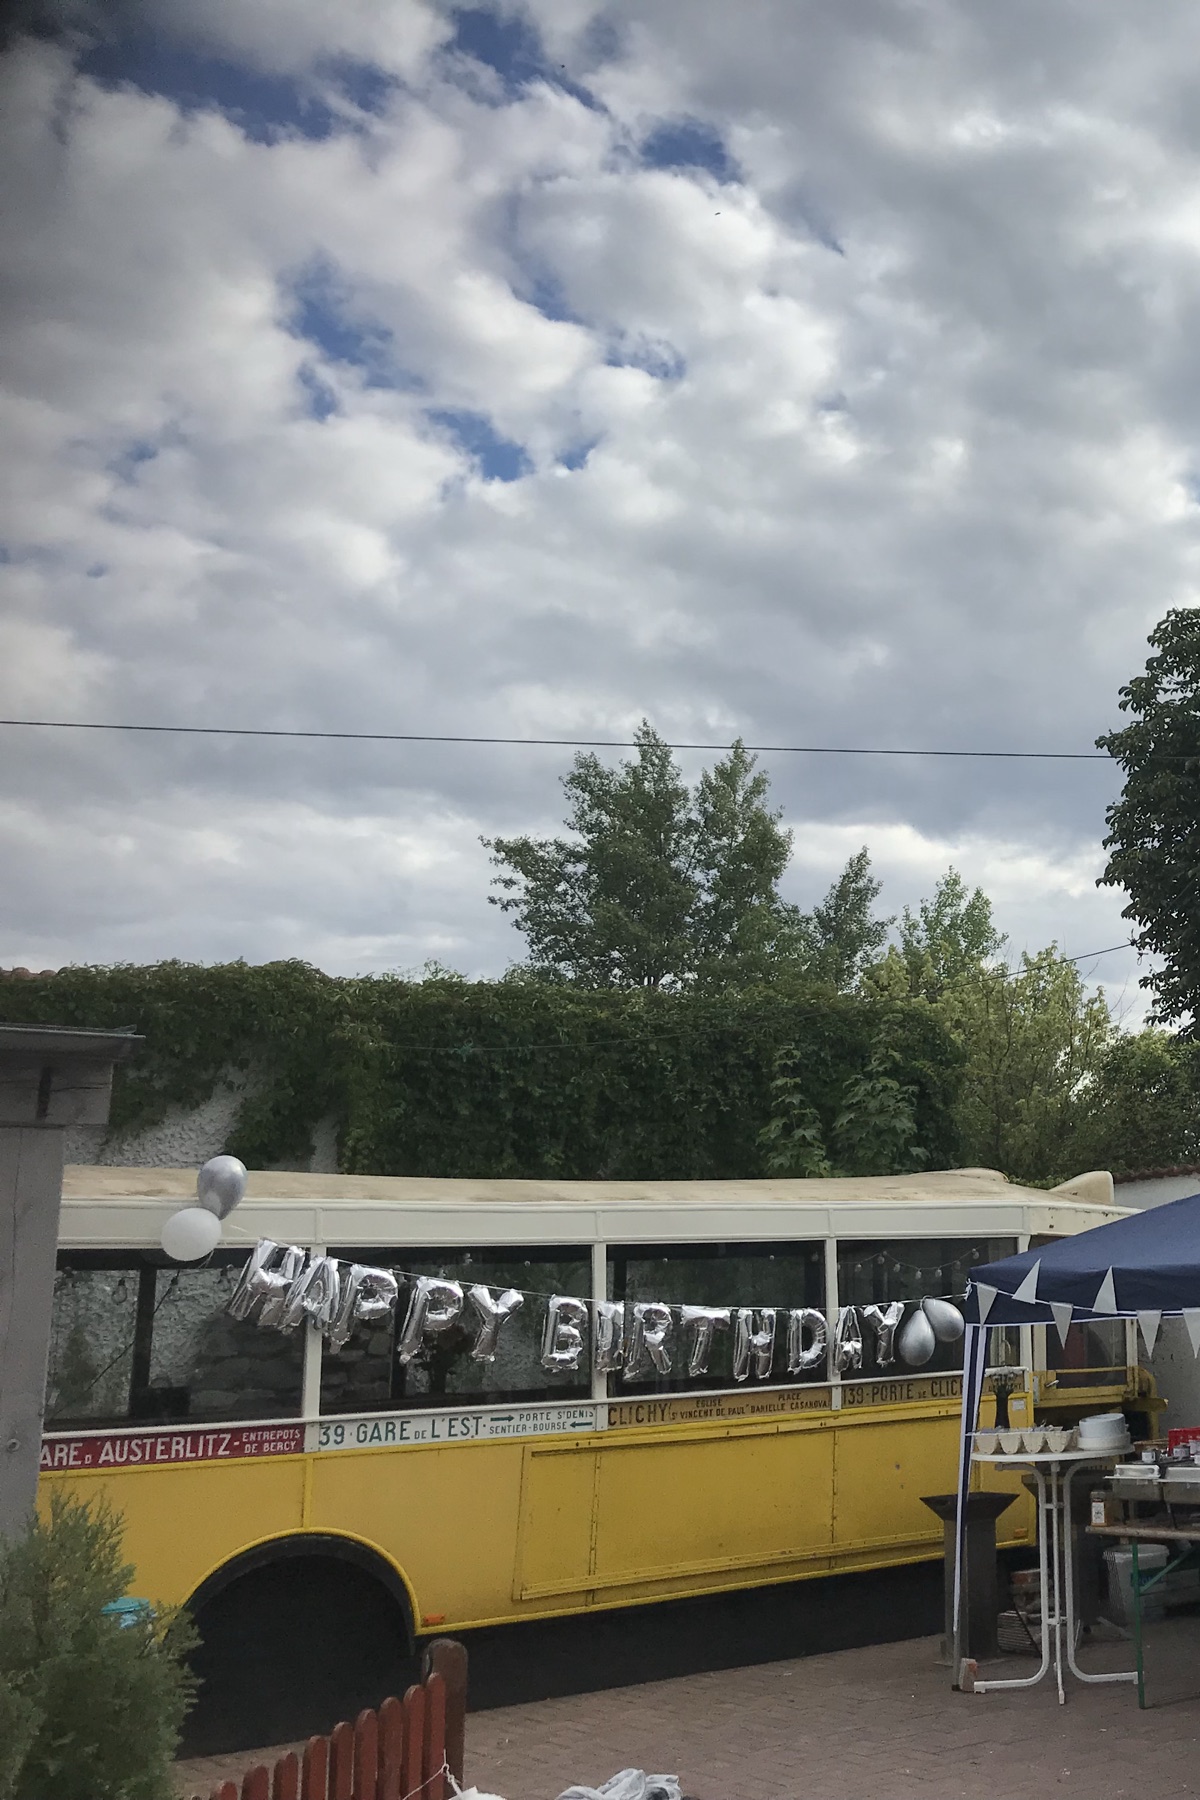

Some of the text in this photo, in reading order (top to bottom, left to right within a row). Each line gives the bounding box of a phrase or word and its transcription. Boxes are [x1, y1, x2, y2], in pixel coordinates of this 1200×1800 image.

[225, 1237, 904, 1381] HAPPY BIRTHDAY
[930, 1379, 963, 1397] CLIC
[778, 1392, 801, 1402] PLACE
[519, 1412, 551, 1422] PORTE
[680, 1408, 713, 1419] VINCENT
[716, 1407, 725, 1416] DE
[728, 1406, 746, 1415] PAUL
[242, 1429, 301, 1443] ENTREPOTS
[319, 1424, 345, 1446] 39
[356, 1420, 411, 1443] GARE
[414, 1429, 427, 1440] DE
[244, 1440, 296, 1454] DE BERCY
[39, 1443, 82, 1467] ARE
